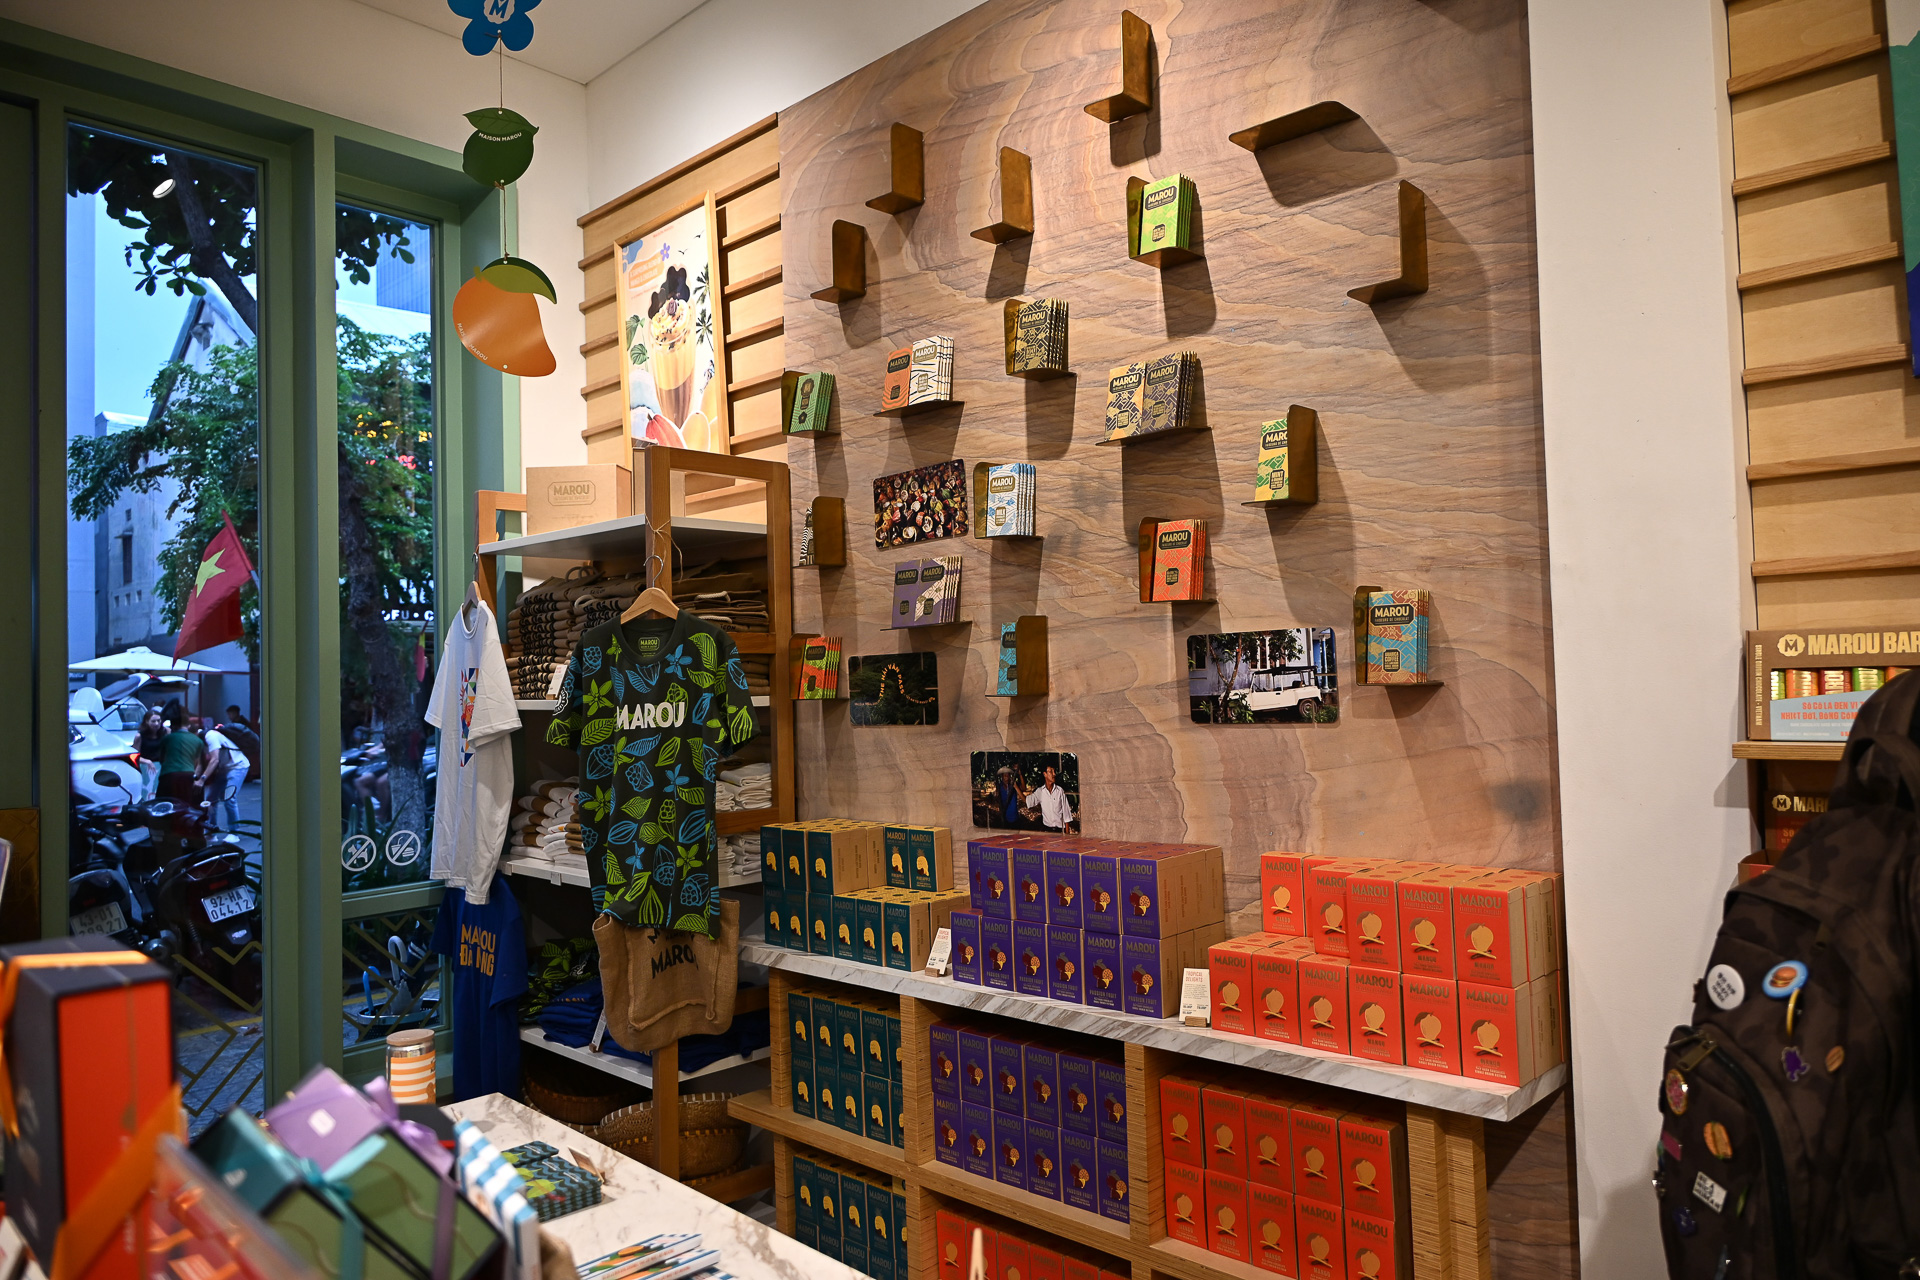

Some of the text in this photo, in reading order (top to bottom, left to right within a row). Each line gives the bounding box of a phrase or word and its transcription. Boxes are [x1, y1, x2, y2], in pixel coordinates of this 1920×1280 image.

[479, 132, 522, 141] MAISON MAROU
[1148, 187, 1174, 203] MAROU
[1021, 311, 1046, 323] MAROU
[469, 343, 488, 361] MAROU
[915, 346, 936, 358] MAROU
[889, 356, 909, 368] MAROU
[1150, 366, 1176, 380] MAROU
[1113, 373, 1139, 387] MAROU
[1265, 431, 1288, 443] MARO
[992, 477, 1013, 487] MAROU
[553, 484, 590, 496] MAROU
[1162, 531, 1188, 543] MAROU
[897, 570, 917, 579] MAROU
[923, 567, 943, 577] MAROU
[1374, 606, 1409, 618] MAROU
[1808, 633, 1880, 655] MAROU
[1883, 631, 1920, 653] BAR
[616, 701, 685, 730] MAROU
[1793, 796, 1829, 813] MAR
[887, 831, 905, 840] MAROU
[911, 834, 931, 842] MAROU
[983, 852, 1005, 861] MAROU
[1016, 854, 1039, 864] MAROU
[1050, 856, 1075, 867] MAROU
[1085, 860, 1112, 872] MAROU
[1124, 864, 1152, 875] MAROU
[1266, 862, 1296, 872] MAROU
[1351, 884, 1389, 897] MAROU
[1404, 889, 1444, 903] MAROU
[210, 891, 243, 908] 92-HA
[834, 901, 853, 910] MAROU
[1460, 893, 1502, 908] MAROU
[210, 899, 251, 921] 044.12
[859, 903, 878, 914] MAROU
[887, 906, 906, 918] MAROU
[954, 917, 975, 928] MAROU
[984, 922, 1008, 933] MAROU
[1017, 926, 1042, 937] MAROU
[1051, 930, 1076, 942] MAROU
[1088, 936, 1115, 949] MAROU
[1126, 941, 1155, 954] MAROU
[1214, 955, 1246, 968] MAROU
[1258, 961, 1291, 975] MAROU
[1305, 968, 1340, 982] MAROU
[1355, 974, 1393, 989] MAROU
[1410, 983, 1449, 998] MAROU
[1466, 988, 1508, 1006] MAROU
[815, 1003, 833, 1014] MAROU
[838, 1010, 857, 1020] MAROU
[864, 1016, 884, 1027] MAROU
[932, 1030, 954, 1042] MAROU
[962, 1037, 984, 1050] MAROU
[994, 1044, 1018, 1058] MAROU
[794, 1058, 811, 1069] MAROU
[1028, 1052, 1052, 1066] MAROU
[1063, 1060, 1088, 1074] MAROU
[1099, 1068, 1125, 1084] MAROU
[867, 1079, 886, 1091] MAROU
[937, 1098, 958, 1112] MAROU
[1208, 1097, 1239, 1112] MAROU
[965, 1107, 988, 1120] MAROU
[1250, 1107, 1283, 1122] MAROU
[997, 1116, 1020, 1130] MAROU
[1296, 1118, 1330, 1134] MAROU
[1029, 1126, 1054, 1140] MAROU
[1346, 1129, 1382, 1146] MAROU
[1065, 1136, 1091, 1150] MAROU
[795, 1162, 813, 1174] MAROU
[1170, 1167, 1199, 1182] MAROU
[818, 1171, 836, 1184] MAROU
[844, 1181, 862, 1193] MAROU
[1210, 1178, 1242, 1194] MAROU
[869, 1190, 888, 1204] MAROU
[1254, 1191, 1288, 1208] MAROU
[1301, 1204, 1336, 1222] MAROU
[1351, 1218, 1387, 1238] MAROU
[821, 1235, 839, 1248] MAROU
[846, 1244, 865, 1258] MAROU
[872, 1255, 892, 1269] MAROU
